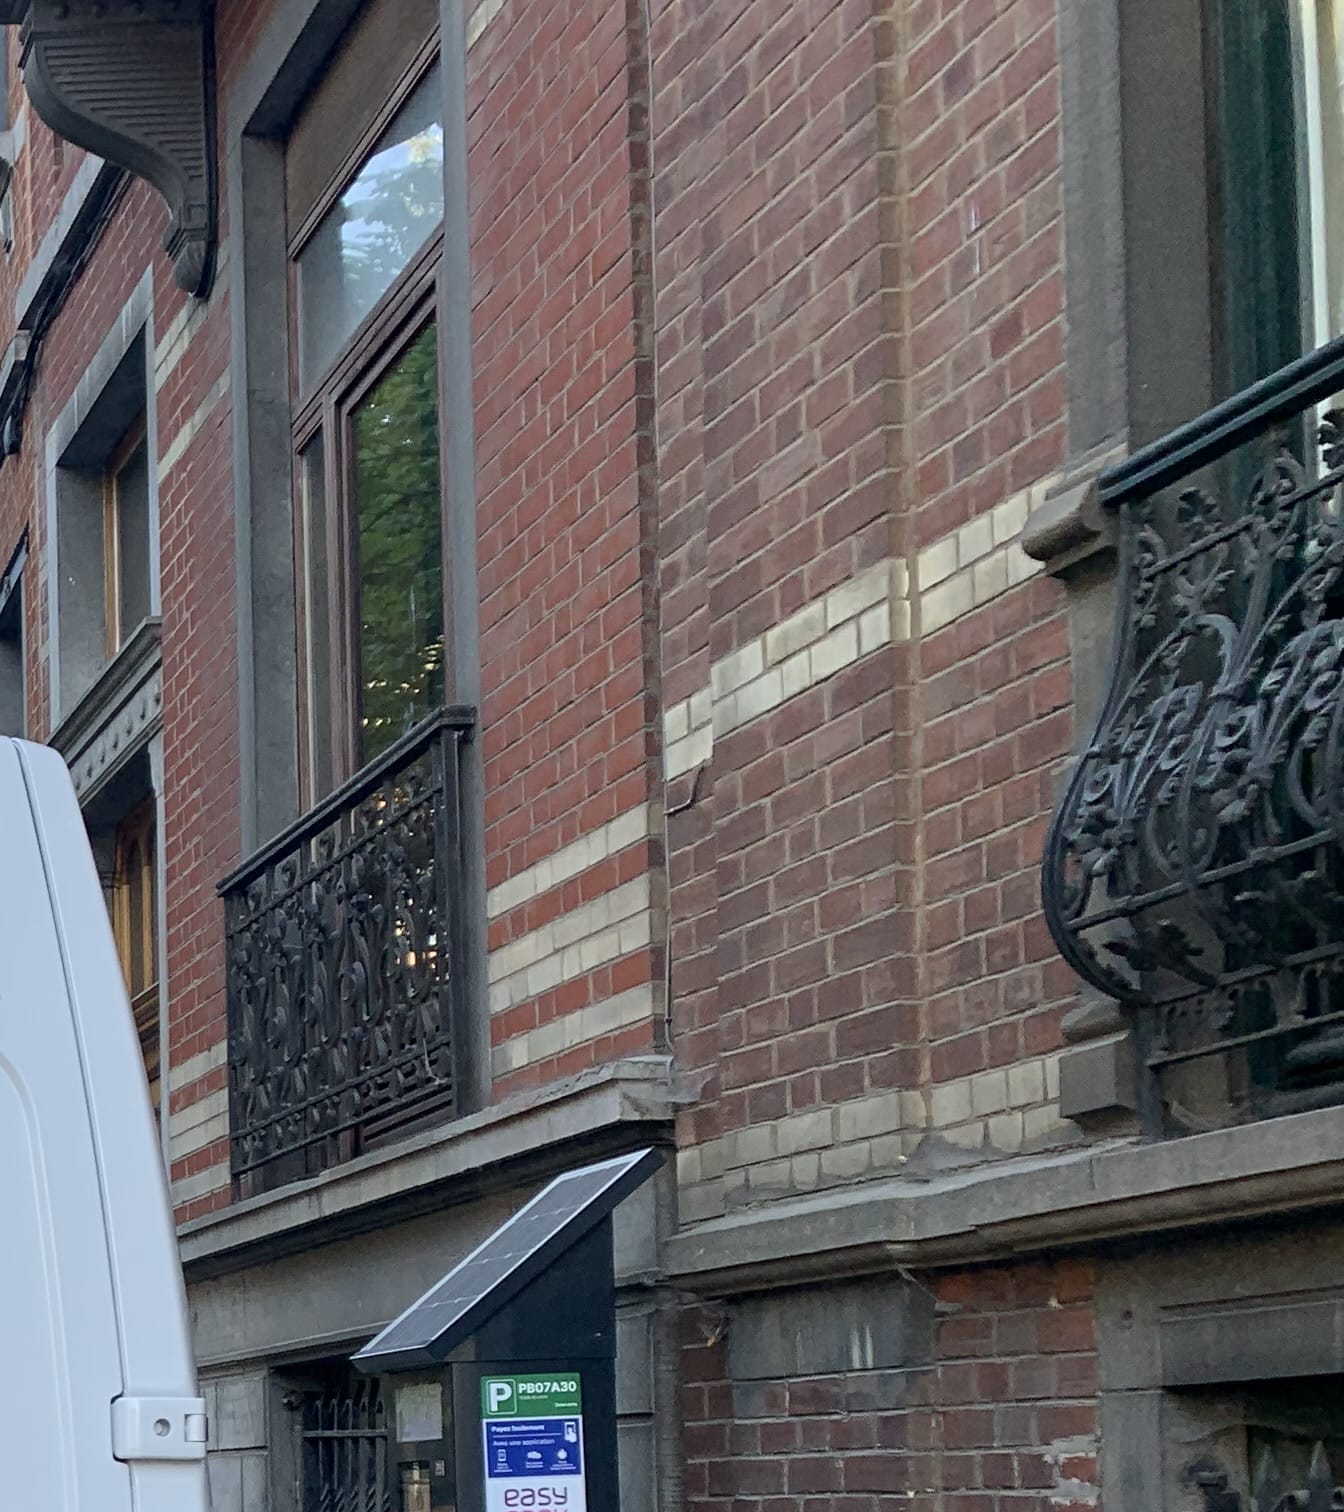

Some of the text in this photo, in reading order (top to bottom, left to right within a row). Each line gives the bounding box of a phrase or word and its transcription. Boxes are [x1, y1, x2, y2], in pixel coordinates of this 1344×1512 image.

[490, 1381, 577, 1412] P PB07A30
[504, 1486, 568, 1507] easy
